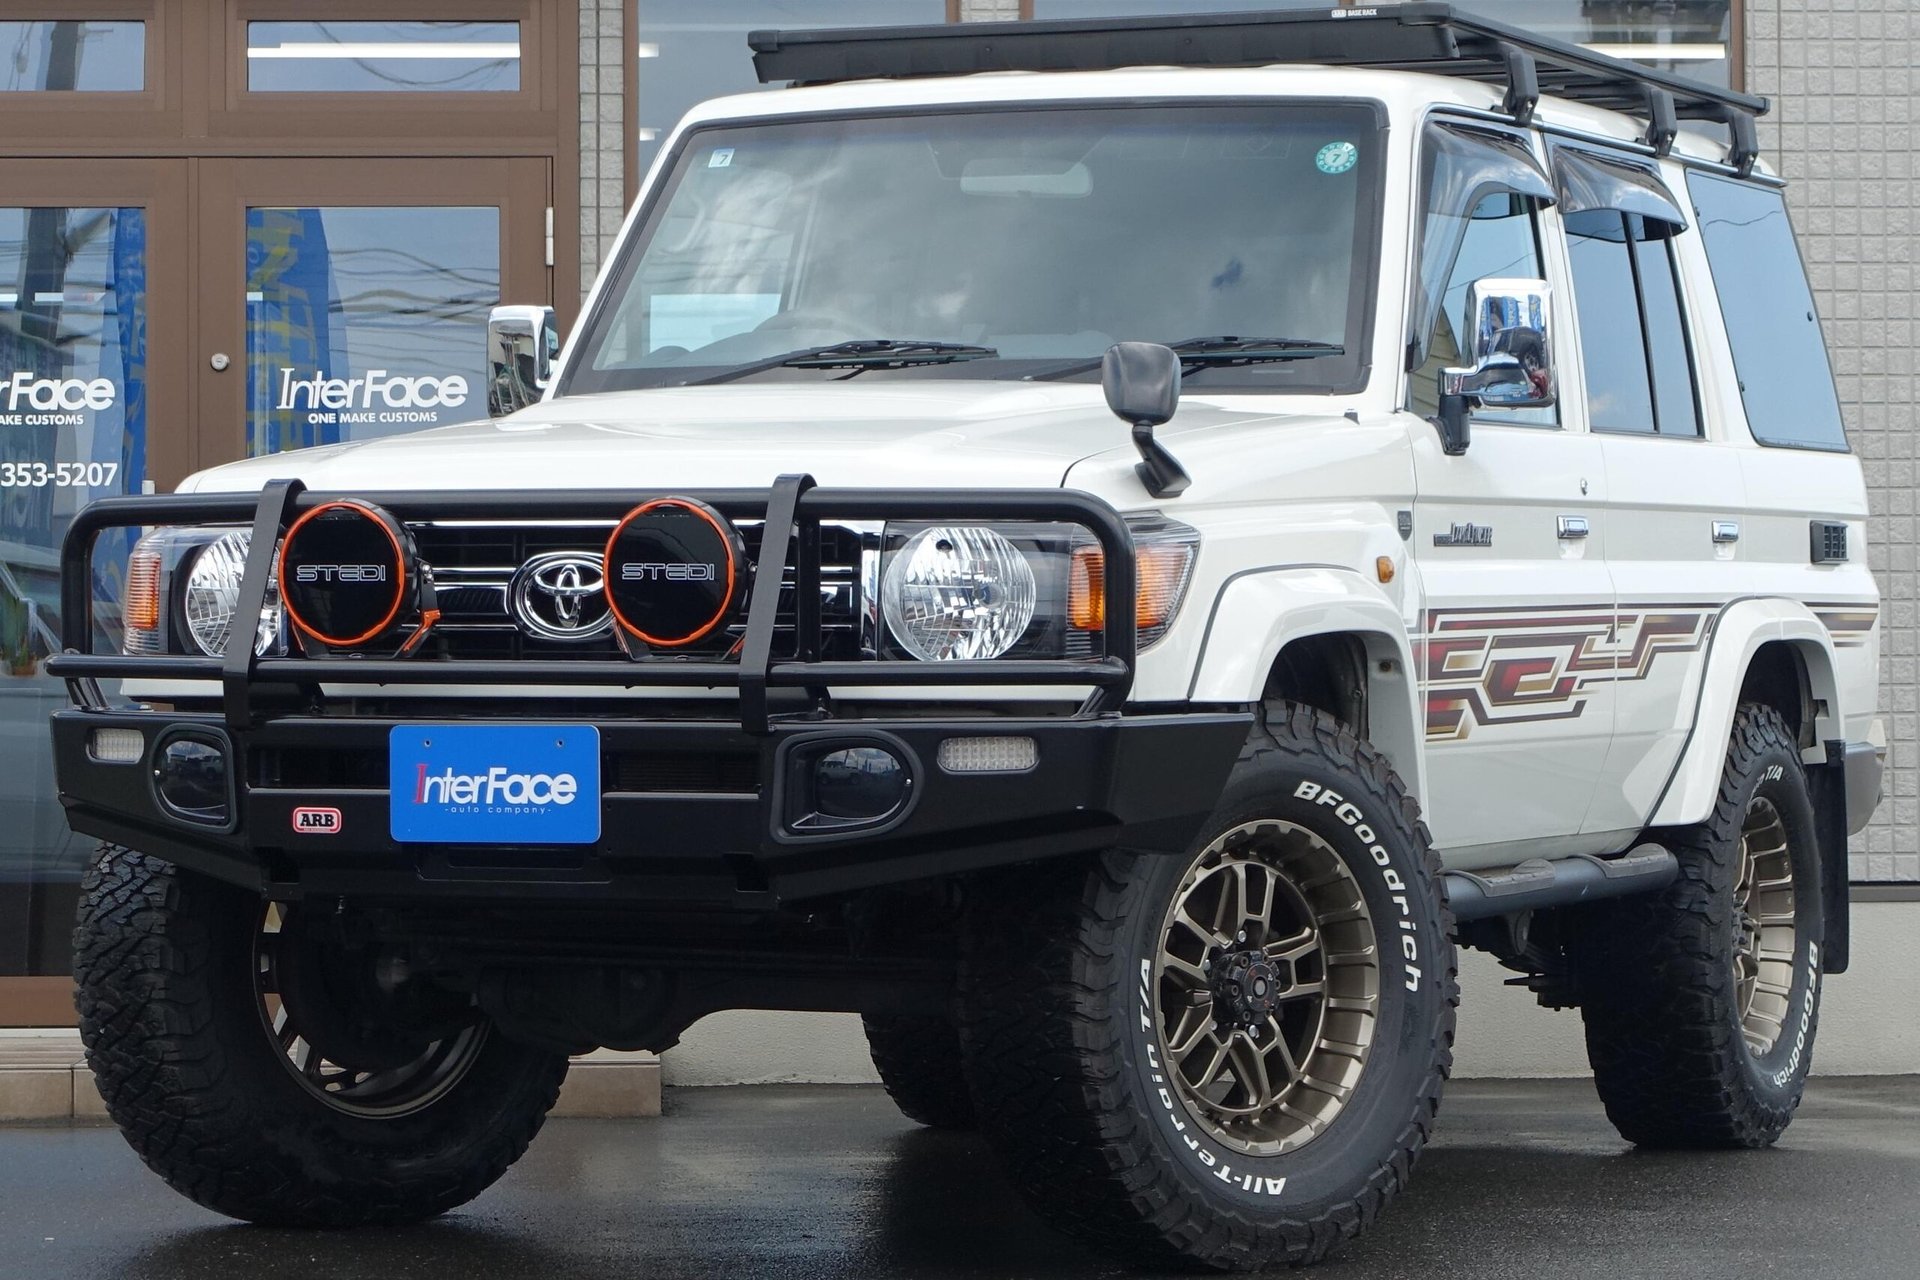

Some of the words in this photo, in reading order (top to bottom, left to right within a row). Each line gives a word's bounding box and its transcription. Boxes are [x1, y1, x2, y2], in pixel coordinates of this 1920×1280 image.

[719, 154, 729, 165] 7
[1332, 153, 1342, 163] 7
[276, 367, 469, 409] InterFace
[25, 414, 84, 425] CUSTOMS
[308, 413, 336, 424] ONE
[339, 412, 376, 423] MAKE
[379, 411, 438, 423] CUSTOMS
[1, 462, 118, 487] 353-5207
[296, 564, 386, 582] STEDI
[621, 562, 715, 581] STEDI
[1765, 765, 1784, 781] T/A
[413, 763, 578, 805] InterFace
[300, 813, 336, 827] ARB
[1294, 780, 1422, 992] BFGoodrich
[1139, 959, 1151, 1033] T/A
[1773, 940, 1819, 1088] BFGoodrich
[1147, 1044, 1287, 1195] All-Terrain
